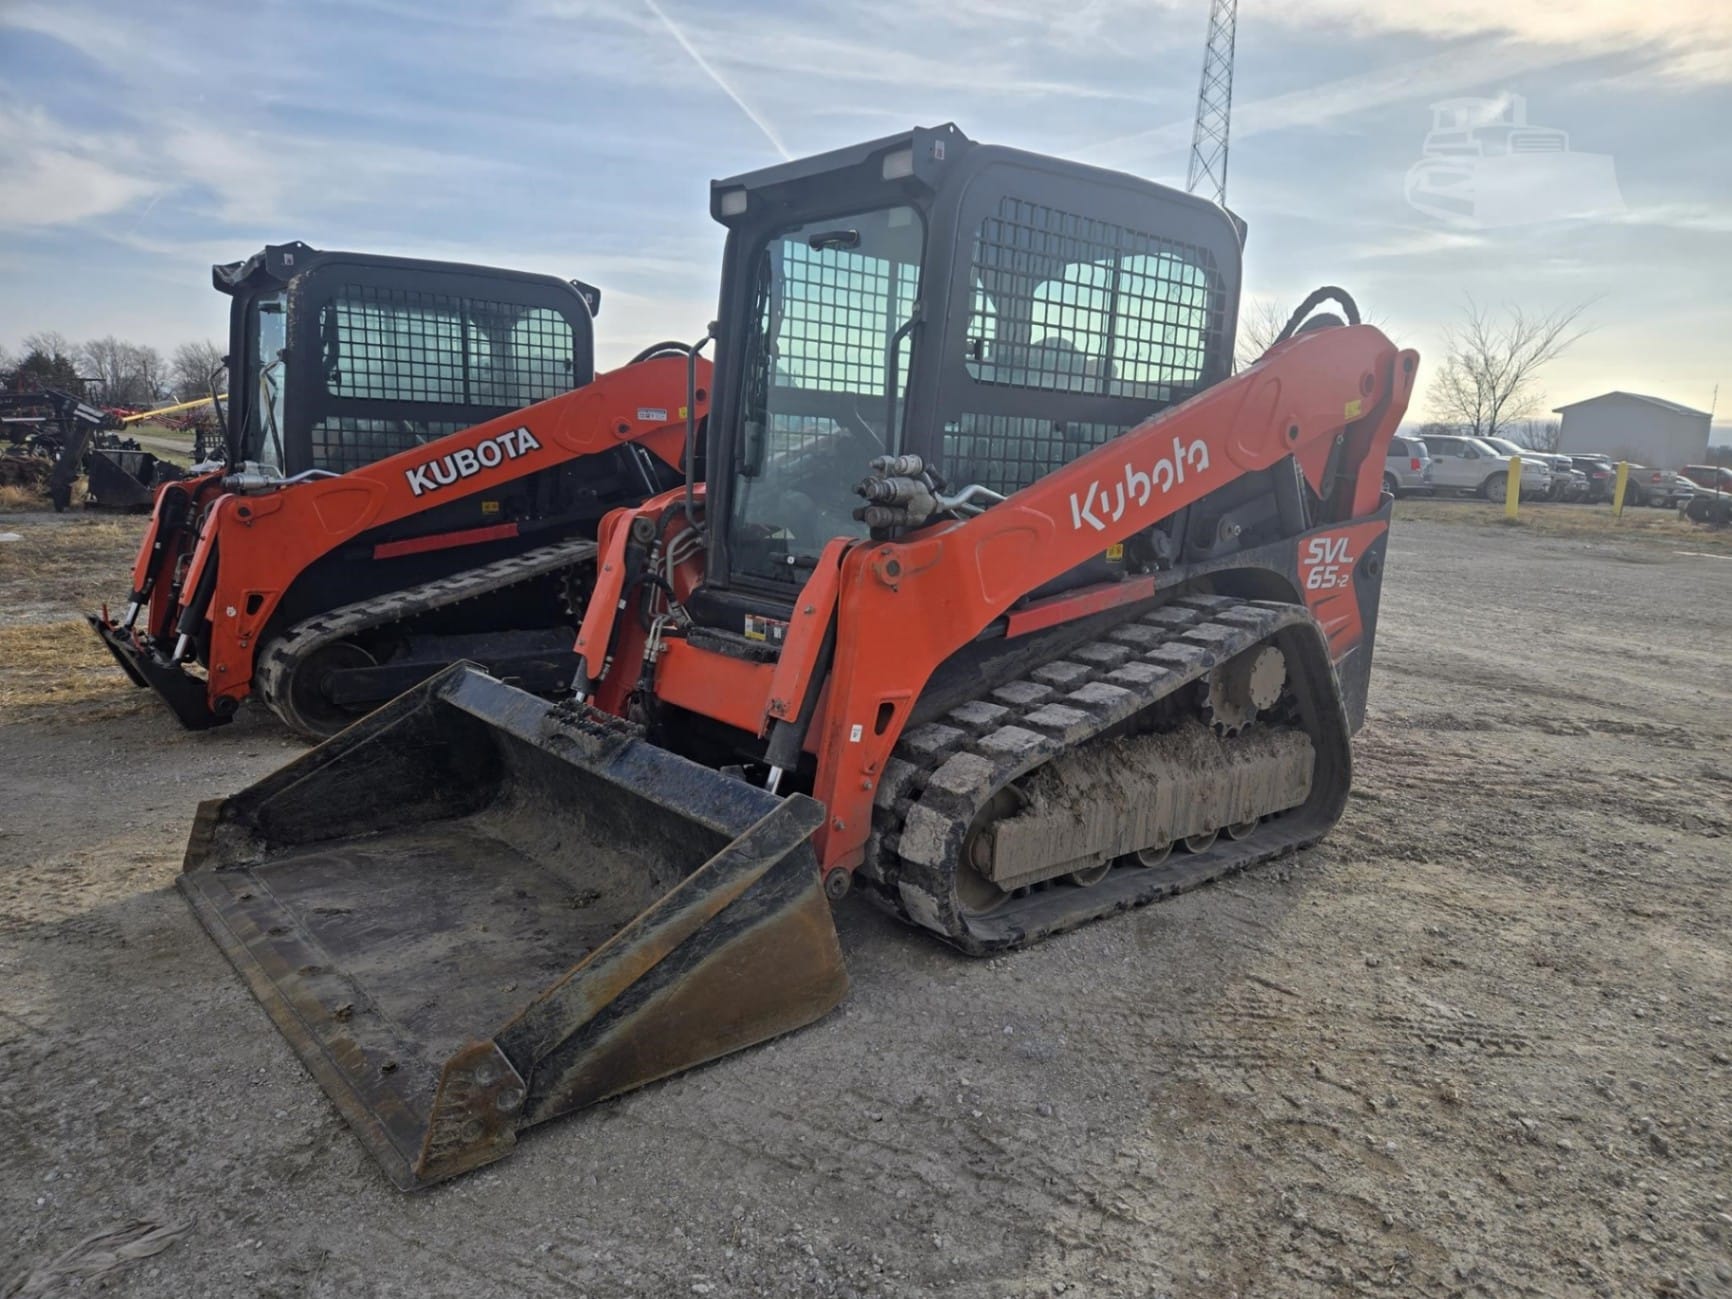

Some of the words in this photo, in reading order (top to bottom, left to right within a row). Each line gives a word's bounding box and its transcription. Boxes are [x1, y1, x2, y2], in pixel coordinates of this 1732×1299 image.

[406, 427, 540, 495] KUBOTA
[1070, 437, 1209, 531] Kubota
[1305, 537, 1354, 564] SVL
